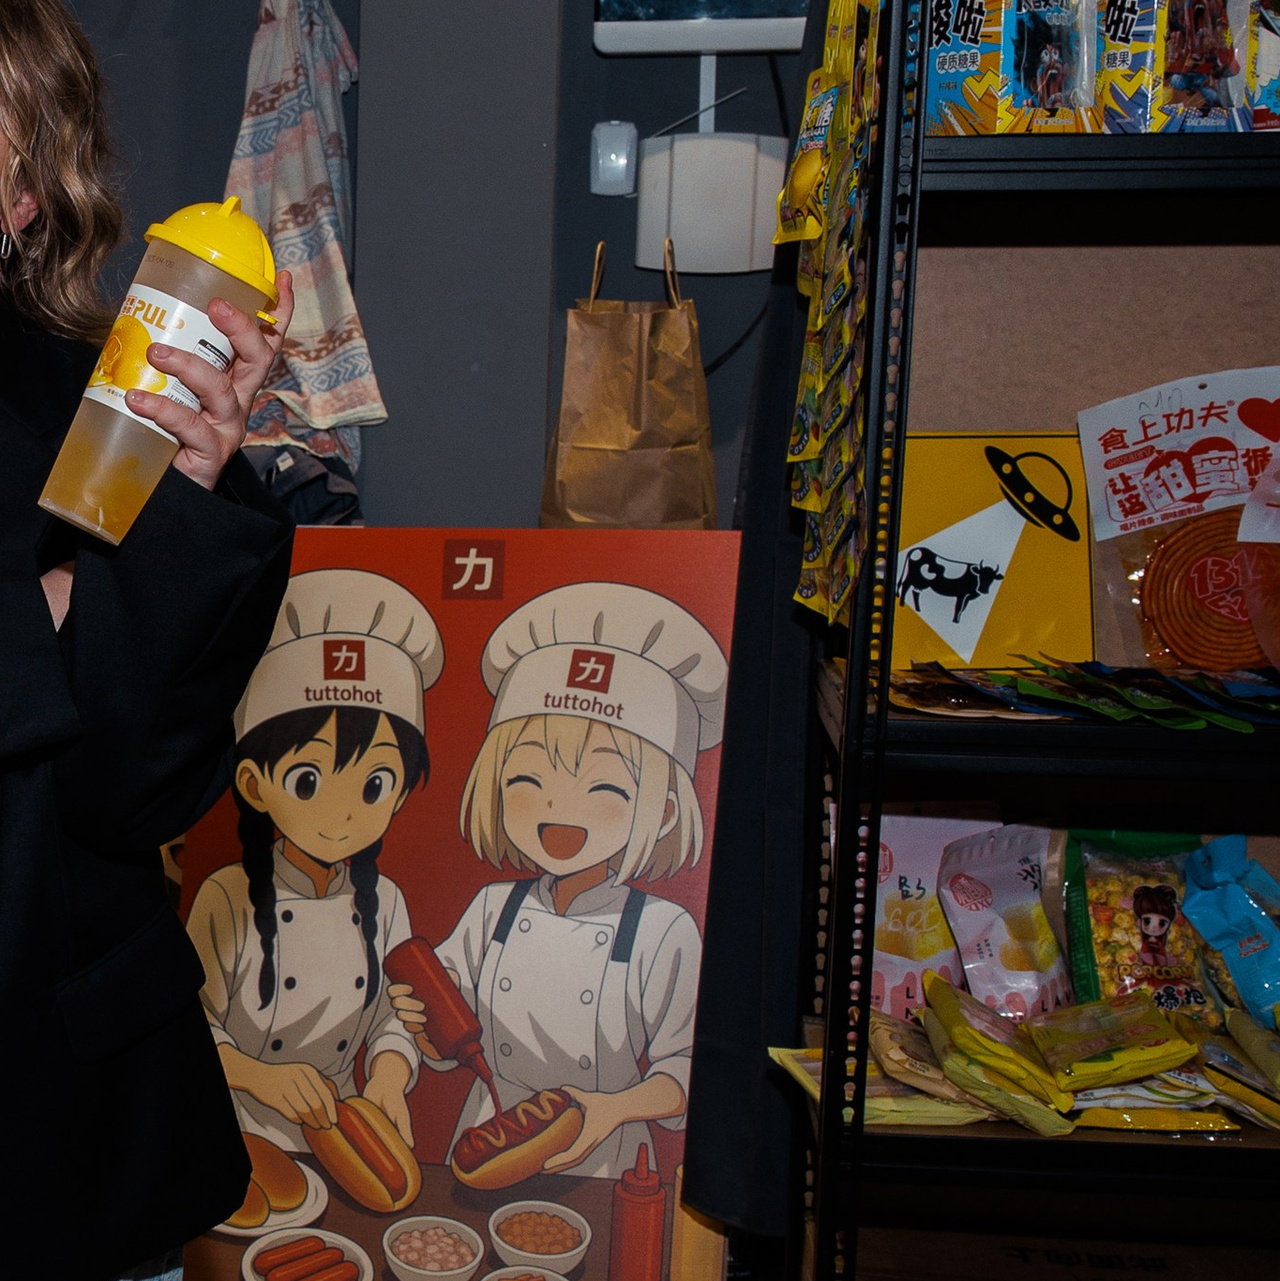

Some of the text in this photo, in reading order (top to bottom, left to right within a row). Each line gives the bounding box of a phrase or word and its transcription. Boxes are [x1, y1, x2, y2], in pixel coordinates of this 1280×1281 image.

[935, 48, 981, 72] 硬质糖果
[1105, 50, 1132, 70] 糖果
[1097, 400, 1230, 456] 食上功夫
[304, 684, 383, 705] tuttohot
[543, 690, 626, 720] tuttohot
[1118, 963, 1198, 982] POPCORN
